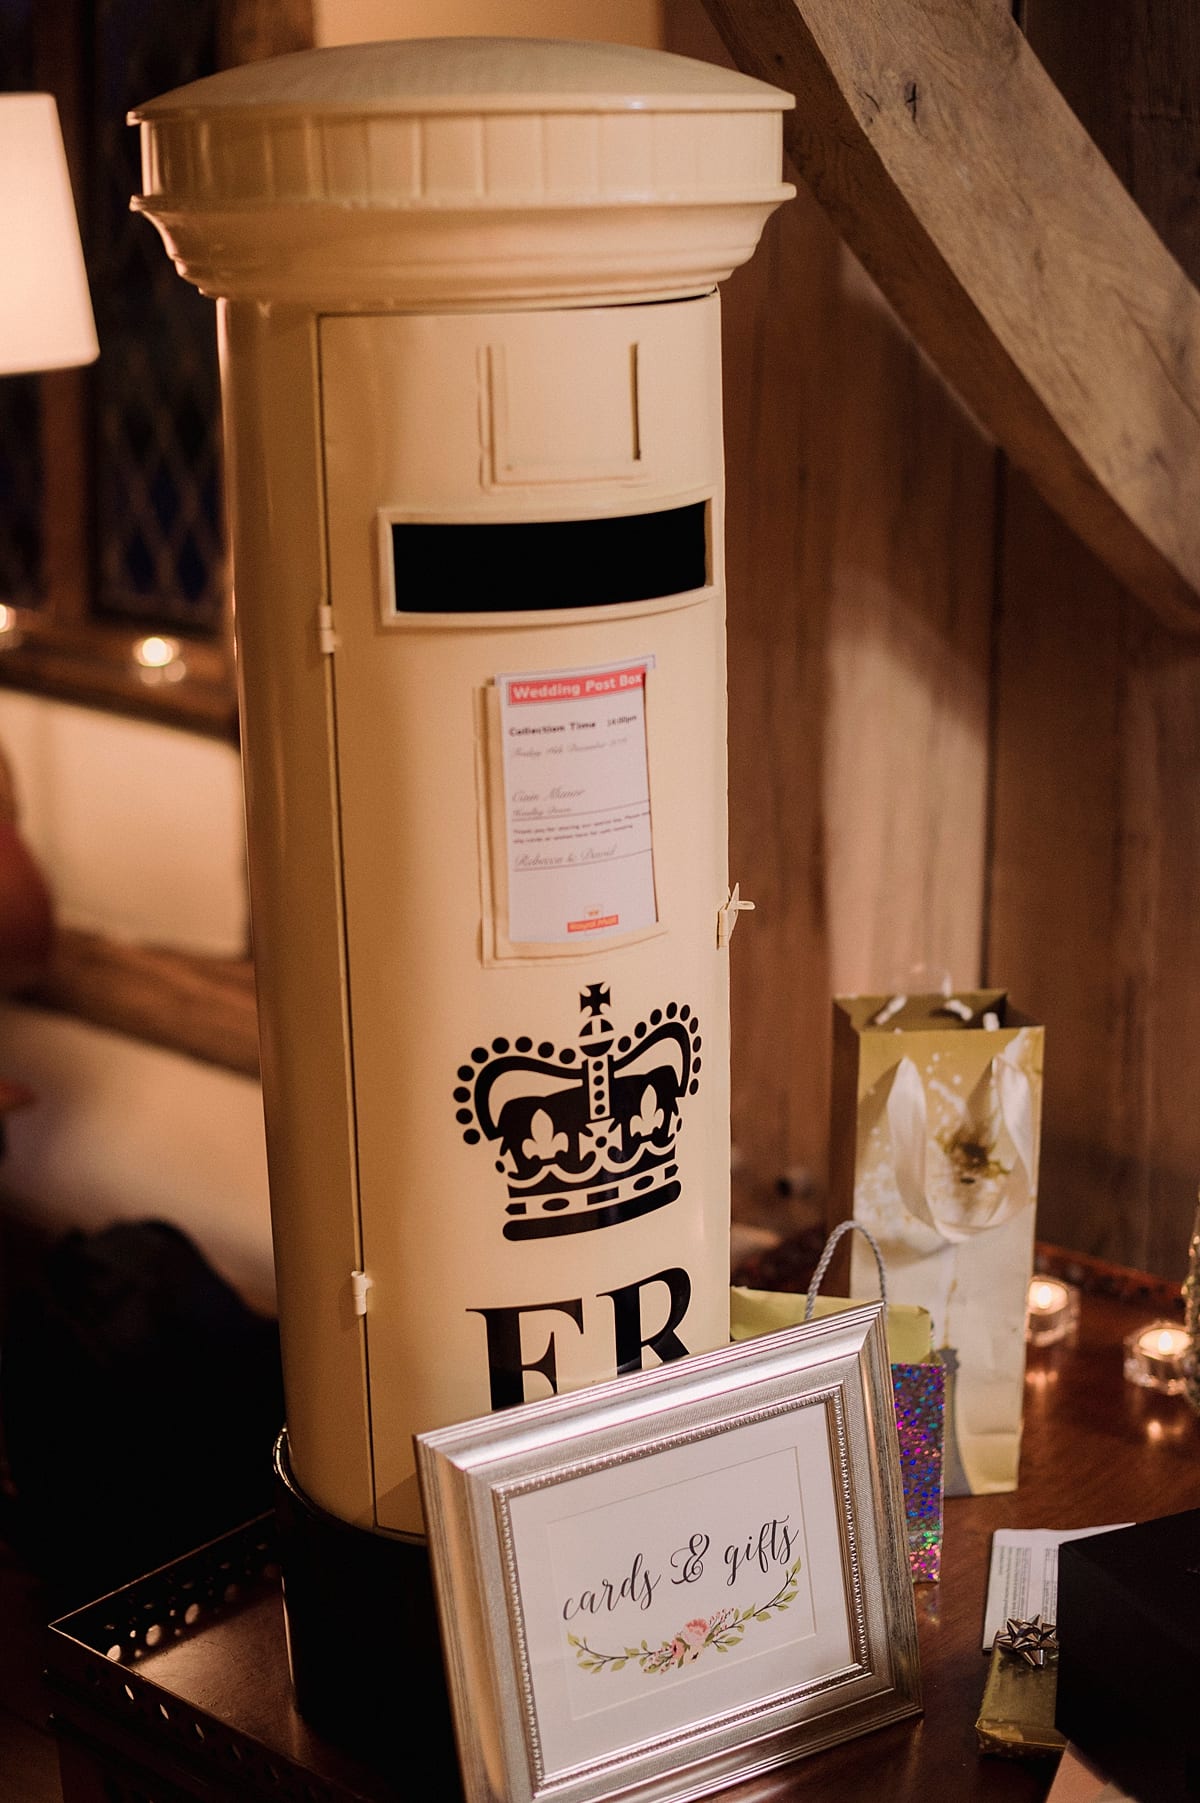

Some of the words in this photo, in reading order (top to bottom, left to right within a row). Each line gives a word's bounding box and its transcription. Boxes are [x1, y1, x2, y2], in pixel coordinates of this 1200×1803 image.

[512, 683, 580, 699] Wedding
[585, 678, 616, 693] Post
[619, 674, 643, 687] Box
[509, 724, 565, 737] Collection
[570, 721, 596, 731] Time
[562, 1553, 661, 1621] cards
[670, 1533, 710, 1585] &
[723, 1515, 799, 1586] gifts
